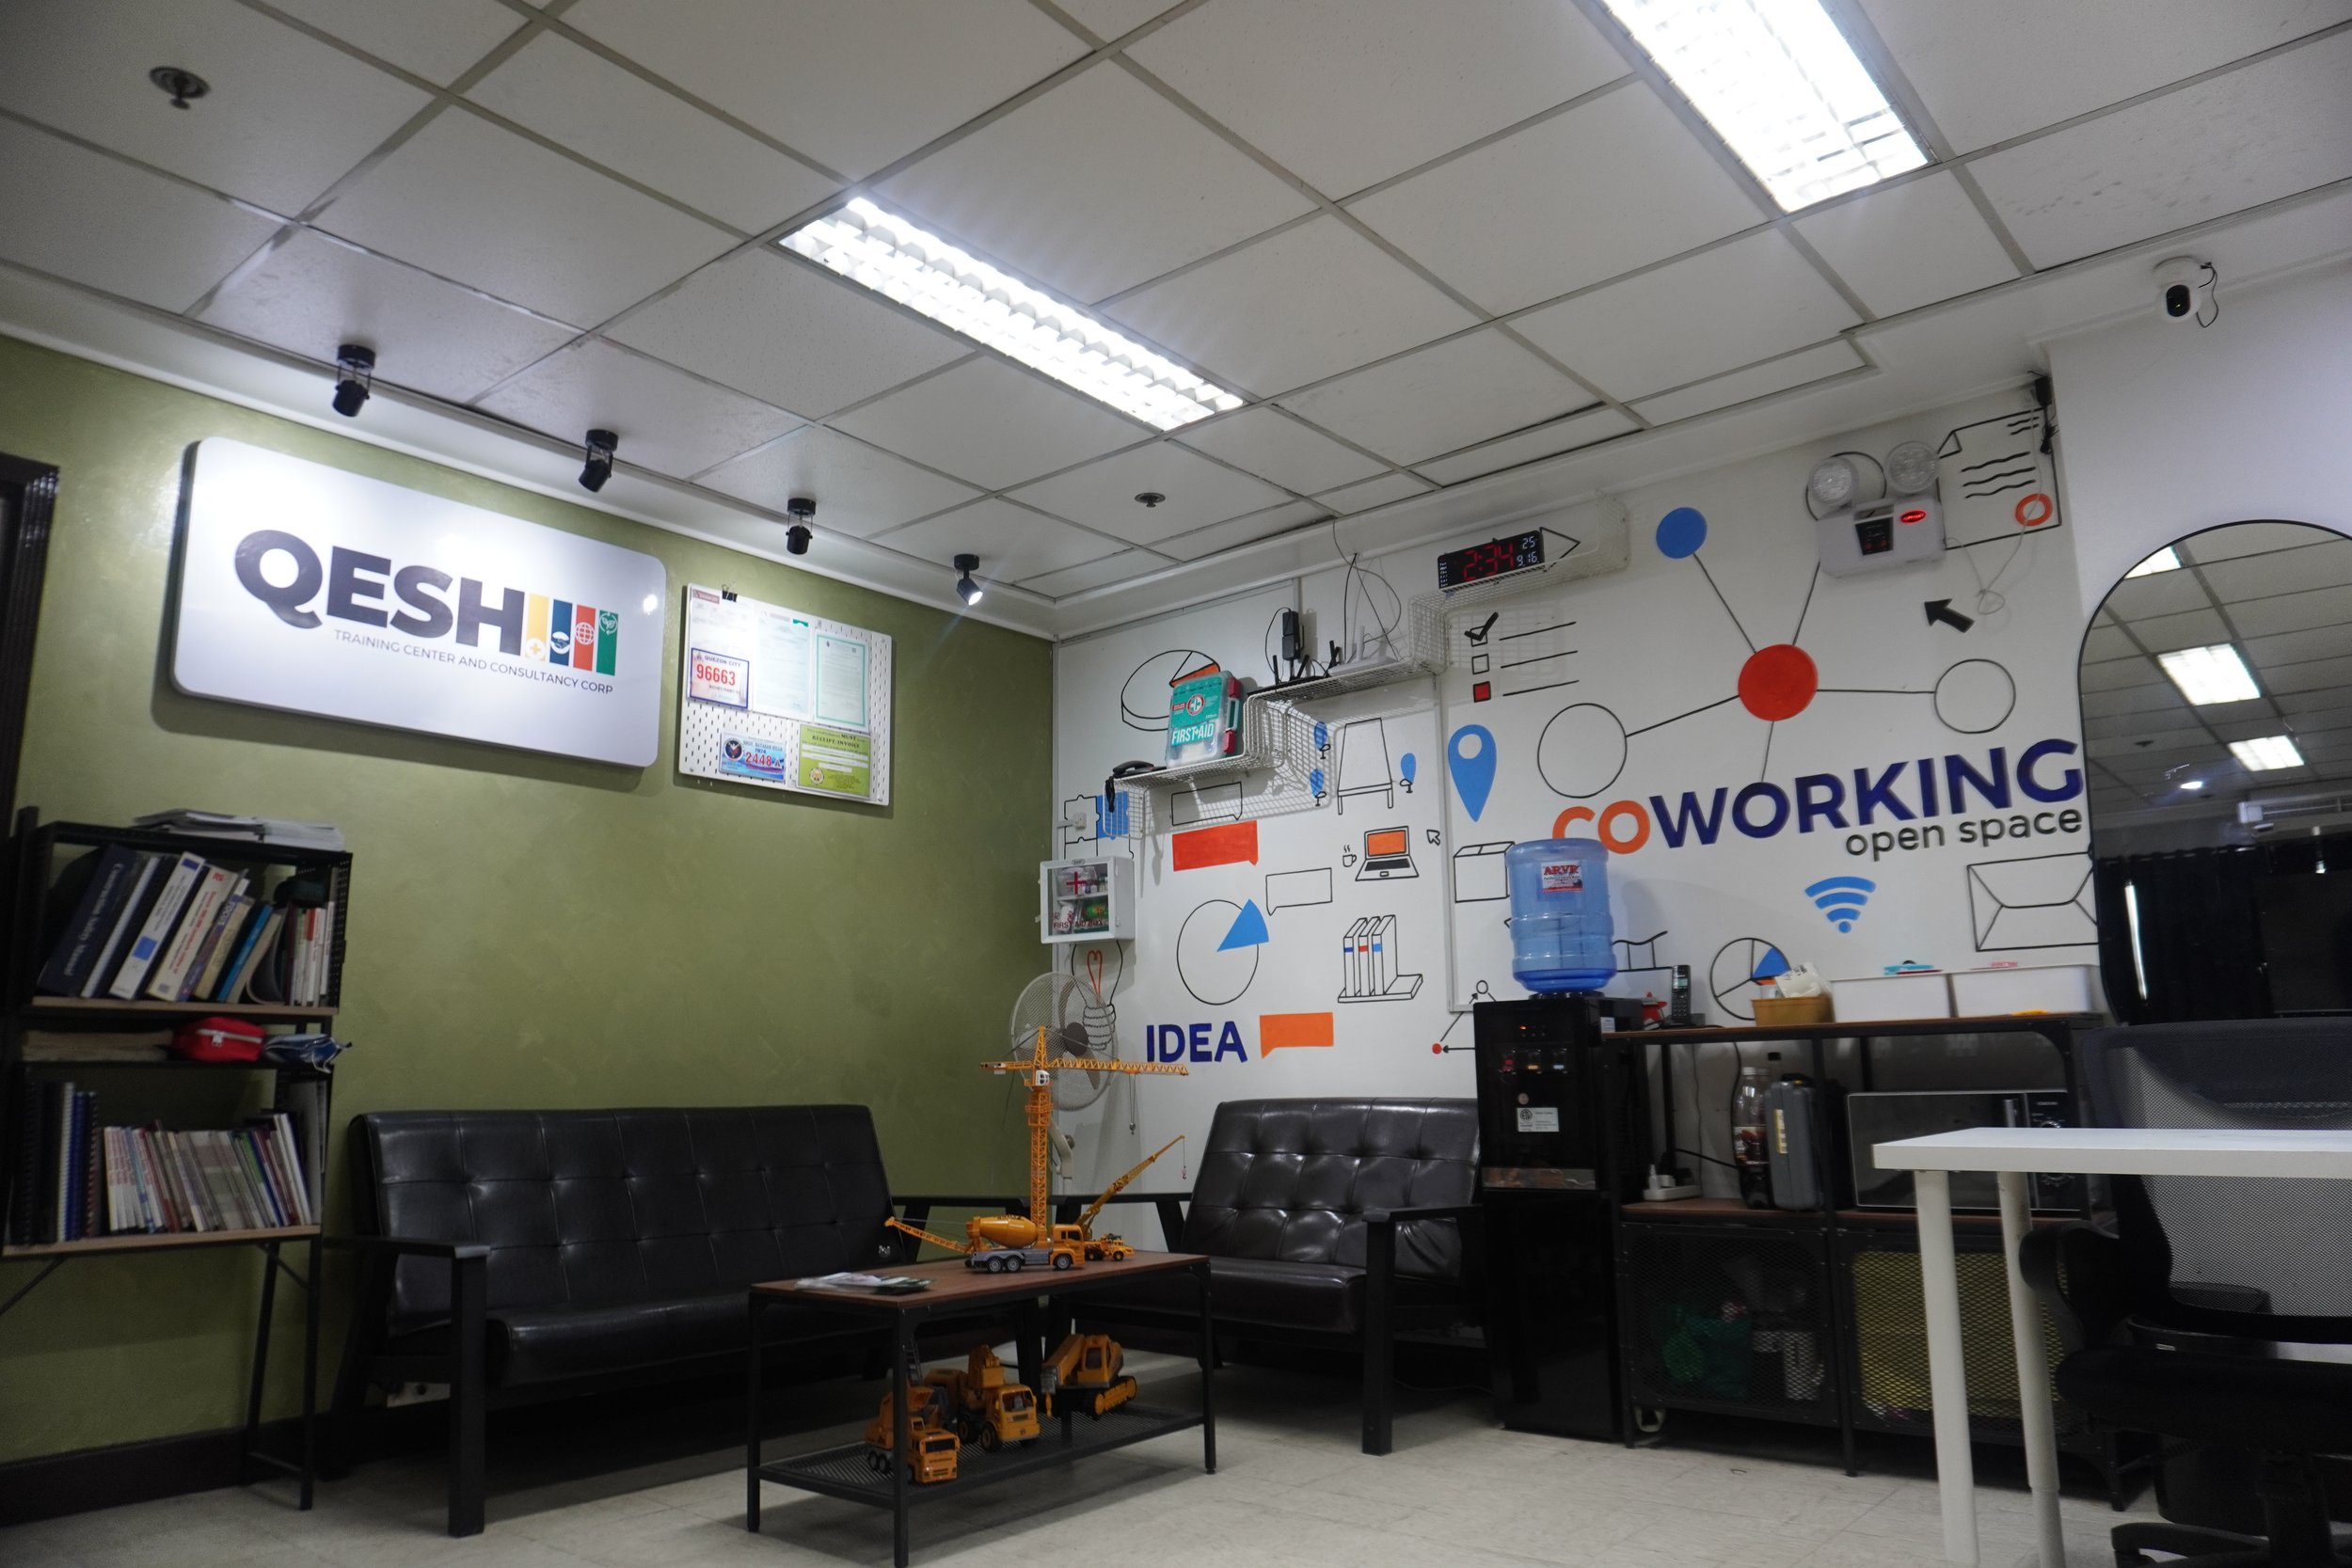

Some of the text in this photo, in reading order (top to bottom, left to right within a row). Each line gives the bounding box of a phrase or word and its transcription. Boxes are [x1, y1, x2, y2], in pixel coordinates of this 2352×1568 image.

[1461, 535, 1535, 582] 2:34 25
[234, 529, 525, 657] QESH
[334, 628, 613, 695] TRAINING CENTER AND CONSULTANCY CORP
[696, 663, 736, 686] 96663
[704, 655, 727, 665] QUEZON
[1171, 723, 1214, 745] FIRST AID
[745, 752, 772, 767] 2448
[1551, 739, 2084, 855] COWORKING
[1846, 807, 2083, 863] open space
[1054, 921, 1072, 929] FIRS
[1146, 1021, 1248, 1063] IDEA
